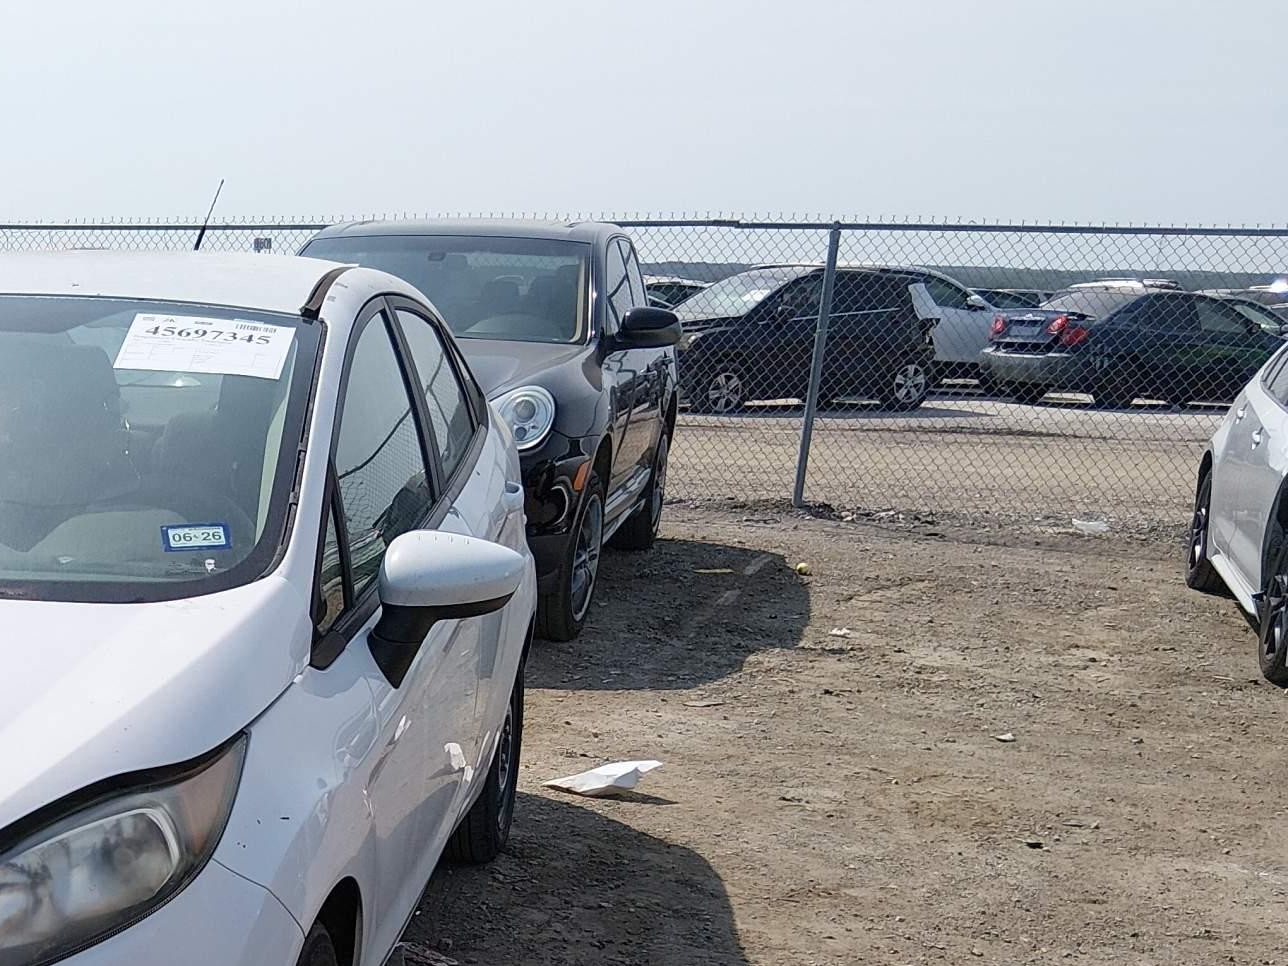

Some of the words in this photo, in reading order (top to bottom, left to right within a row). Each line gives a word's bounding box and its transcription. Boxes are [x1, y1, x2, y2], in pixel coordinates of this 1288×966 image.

[145, 325, 272, 345] 45697345
[172, 532, 193, 543] 06
[201, 531, 222, 541] 26
